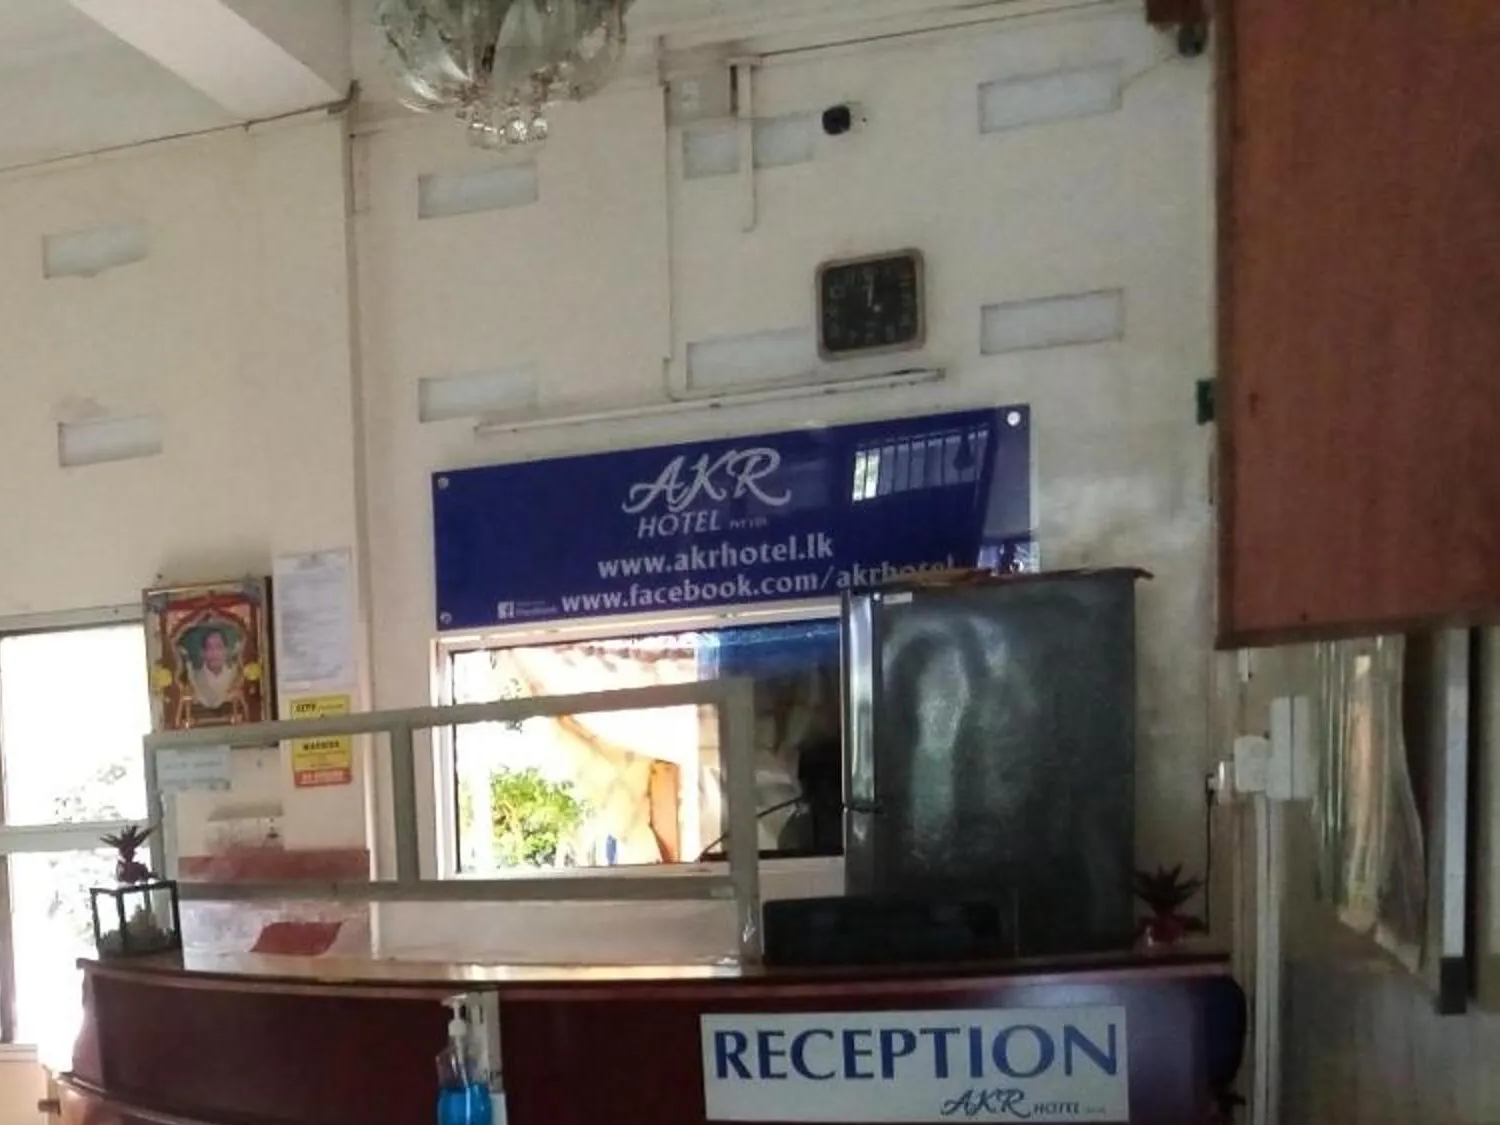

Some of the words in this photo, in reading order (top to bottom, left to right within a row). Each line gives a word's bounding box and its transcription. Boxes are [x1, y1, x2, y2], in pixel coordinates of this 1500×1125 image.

[621, 447, 791, 513] AKR
[637, 509, 721, 539] HOTEL
[597, 532, 834, 579] www.akrhotel.lk
[712, 1023, 1118, 1080] RECEPTION
[940, 1088, 1031, 1119] AKR
[1033, 1102, 1080, 1115] HOTEL
